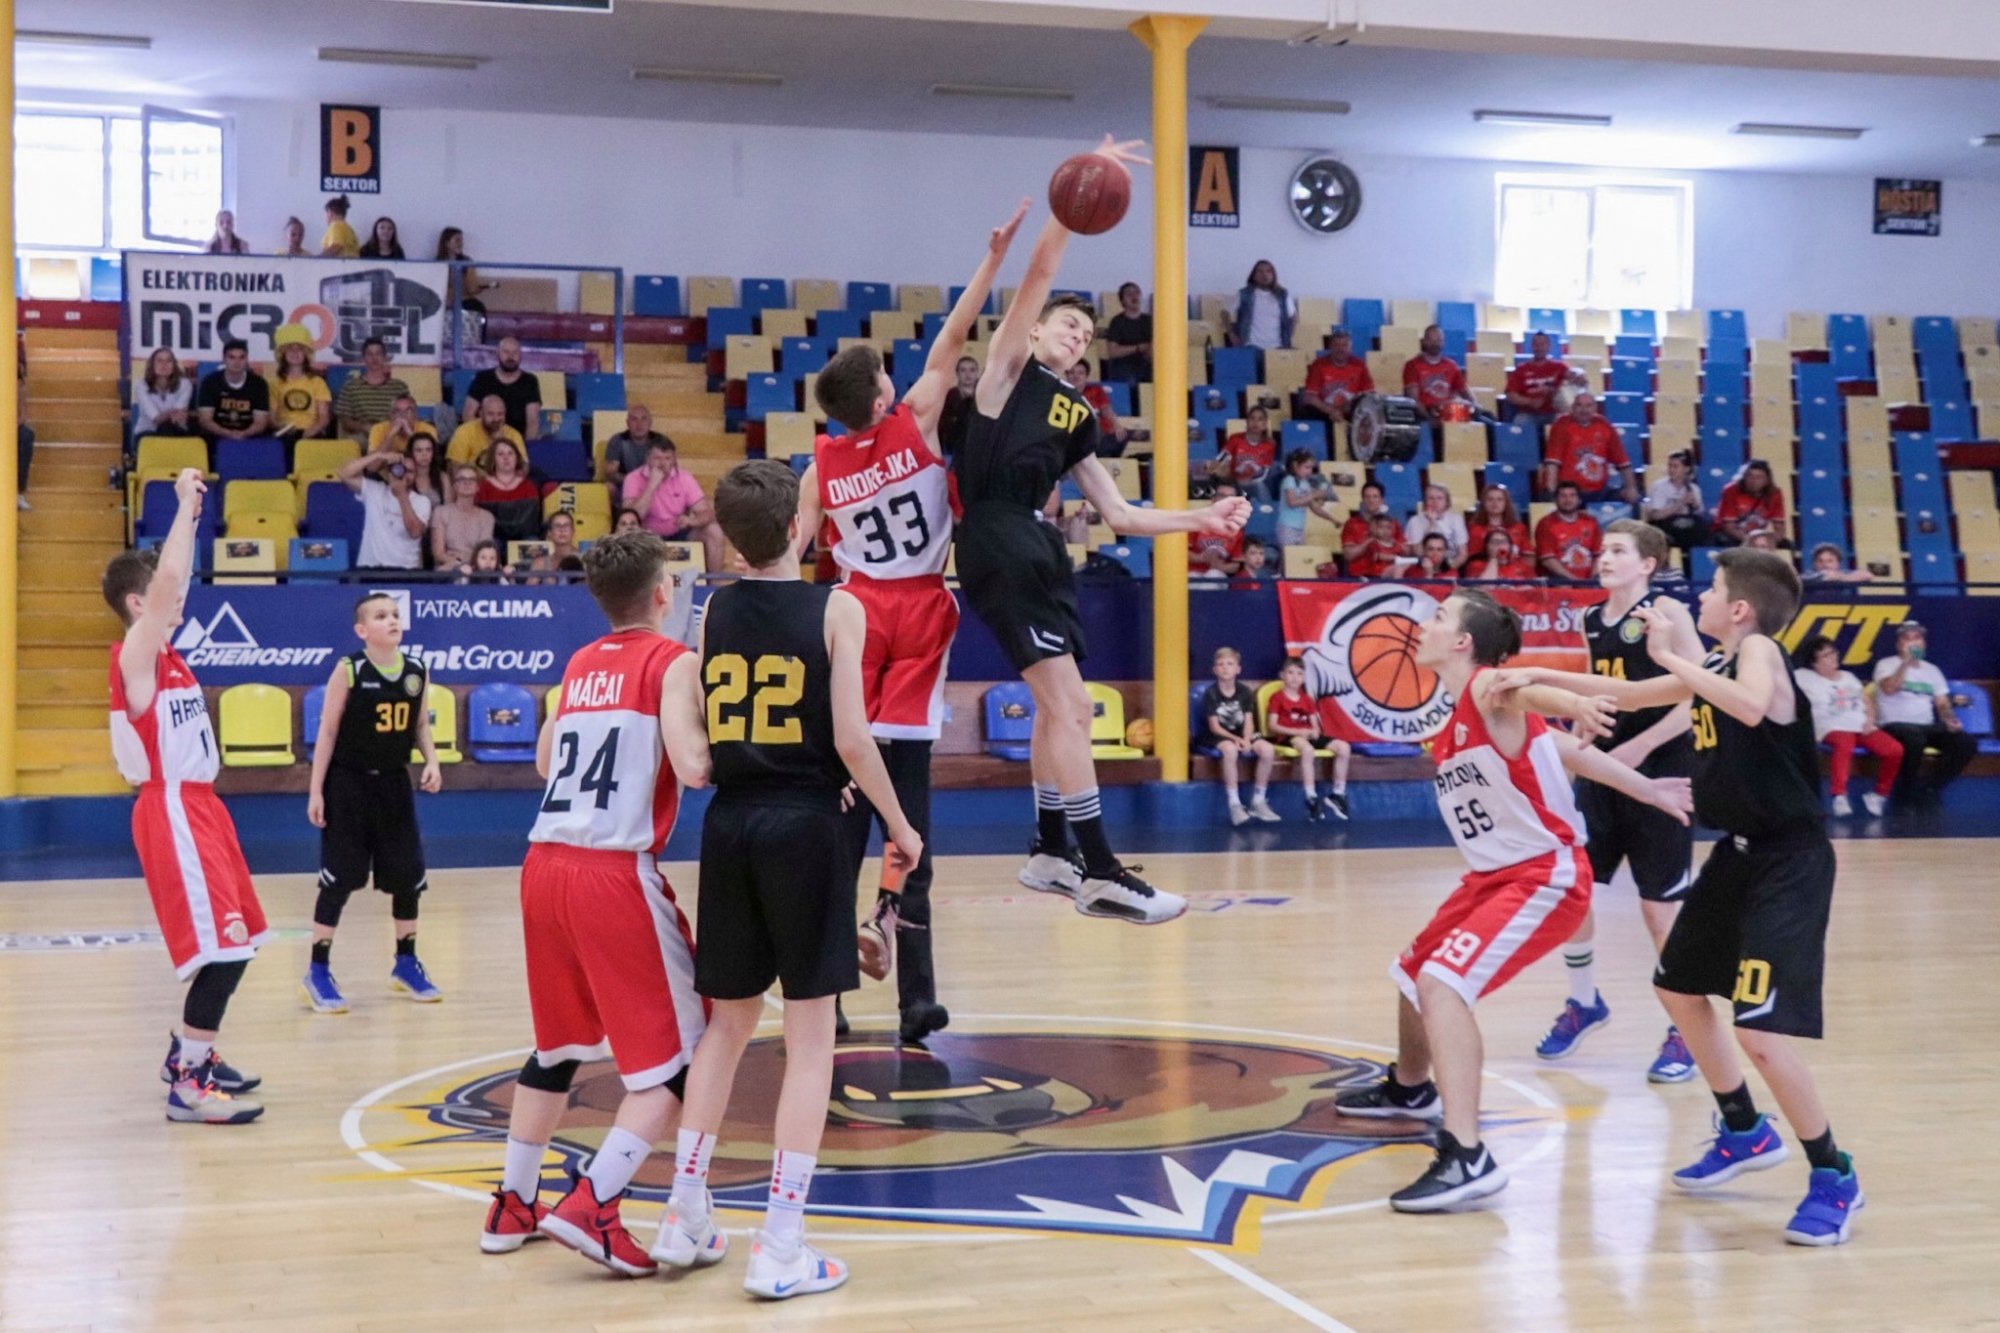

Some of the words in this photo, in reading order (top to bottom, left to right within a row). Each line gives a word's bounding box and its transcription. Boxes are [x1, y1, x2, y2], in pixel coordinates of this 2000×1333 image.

[331, 109, 372, 176] B
[323, 177, 378, 192] SEKTOR
[1195, 151, 1234, 213] A
[1192, 213, 1238, 227] SEKTOR
[142, 270, 286, 293] ELEKTRONIKA
[1047, 392, 1090, 434] 60
[827, 448, 919, 505] ONDREJKA
[853, 490, 930, 564] 33
[414, 599, 553, 619] TATRACLIMA
[187, 647, 334, 667] CHEMOSVIT
[566, 671, 625, 708] MÁČAI
[705, 653, 806, 744] 22
[375, 702, 411, 732] 30
[540, 726, 621, 813] 24
[1454, 798, 1494, 840] 59
